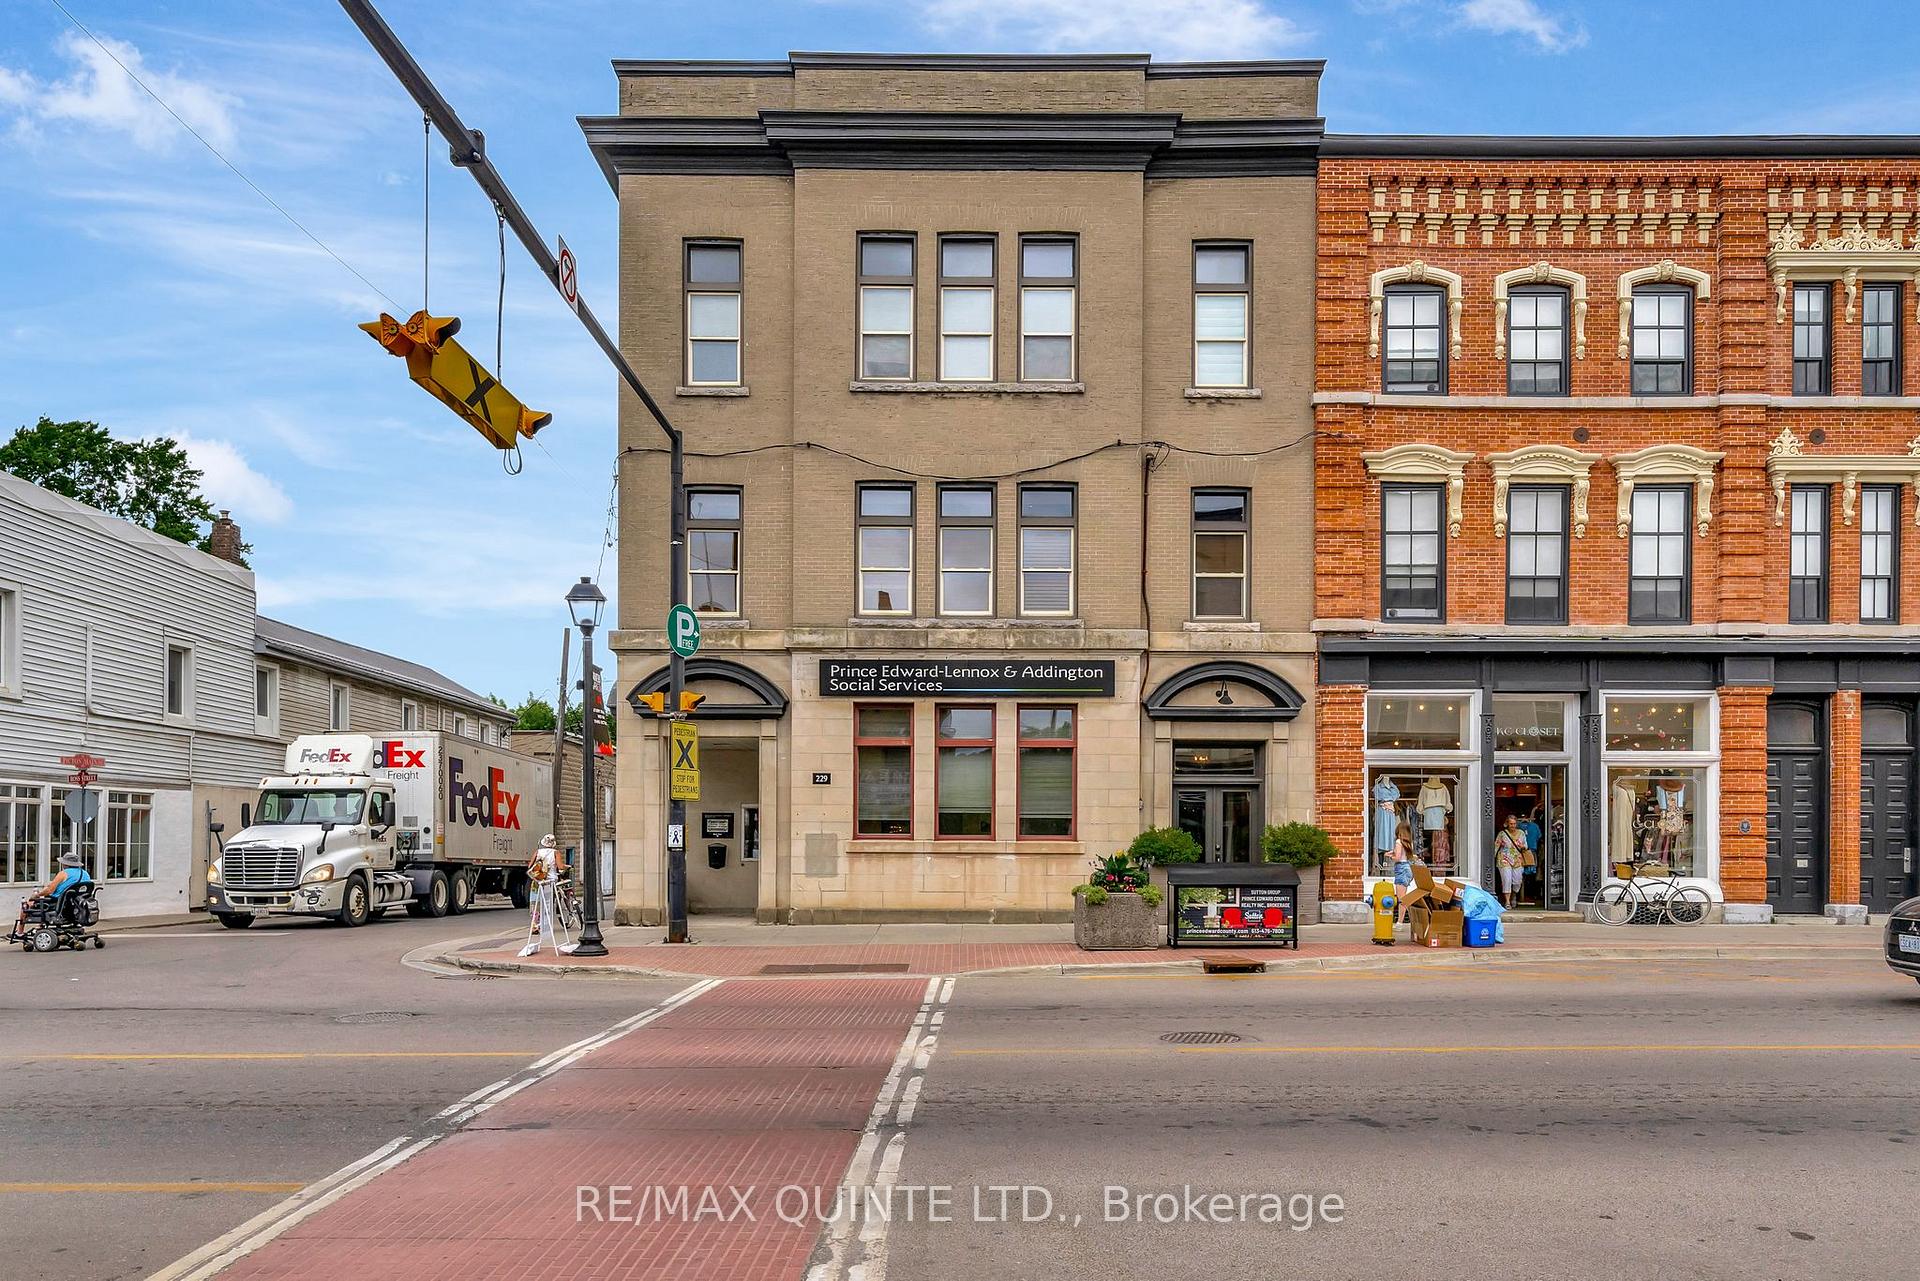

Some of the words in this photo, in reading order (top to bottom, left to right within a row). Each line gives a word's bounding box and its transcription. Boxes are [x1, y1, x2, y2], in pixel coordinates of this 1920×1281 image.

[677, 611, 694, 647] P
[830, 665, 878, 678] Prince
[882, 665, 1000, 678] Edward-Lennox
[1003, 665, 1018, 678] &
[1021, 665, 1104, 681] Addington
[830, 678, 875, 692] Social
[879, 678, 944, 692] Services
[674, 727, 696, 737] PEDESTRIAN
[1515, 727, 1560, 737] CLOSET
[299, 748, 353, 763] FedEx
[675, 739, 695, 769] X
[387, 770, 420, 782] Freight
[676, 774, 686, 783] STOP
[687, 775, 695, 784] FOR
[815, 774, 829, 783] 229
[449, 756, 521, 831] FedEx
[673, 785, 698, 794] PEDESTRIANS
[492, 832, 513, 854] Freight
